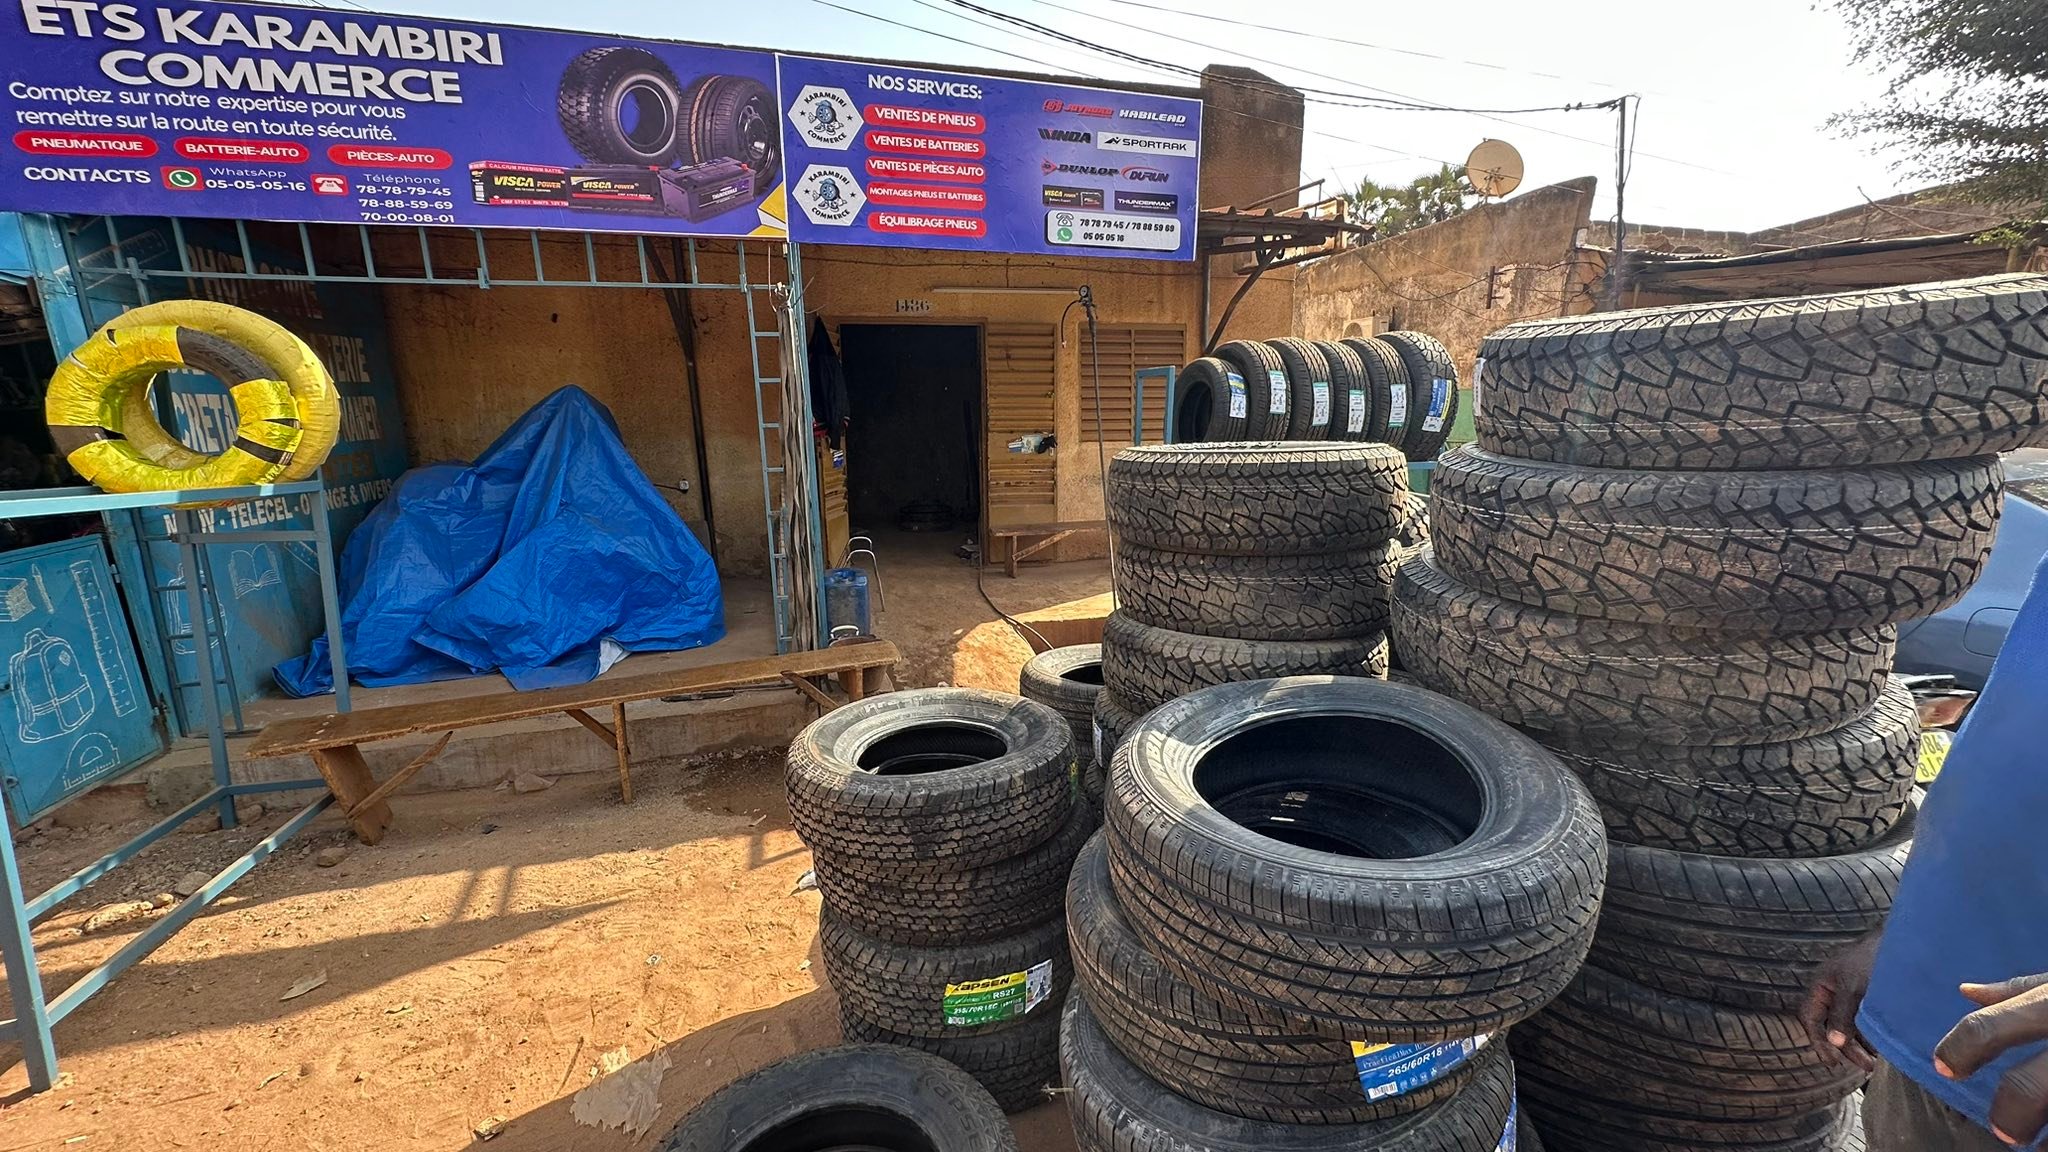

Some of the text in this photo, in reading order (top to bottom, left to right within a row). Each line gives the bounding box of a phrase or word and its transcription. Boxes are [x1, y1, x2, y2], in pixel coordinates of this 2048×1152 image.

[21, 0, 503, 66] ETS KARAMBIRI
[100, 49, 463, 103] COMMERCE
[868, 74, 983, 100] NOS SERVICES:
[8, 81, 406, 119] Comptez sur notre expertise pour vous
[803, 91, 847, 108] KARAMBIRI
[875, 107, 977, 128] VENTES DE PNEUS
[1119, 109, 1187, 124] HABILEAD
[16, 109, 398, 141] remettre sur la route en toute sécurité.
[807, 129, 848, 144] COMMERCE
[872, 134, 979, 153] VENTES DE BATTERIES
[1037, 128, 1091, 144] WINDA
[31, 137, 143, 151] PNEUMATIQUE
[185, 143, 299, 158] BATTERIE-AUTO
[1122, 138, 1187, 151] SPORTRAK
[347, 149, 435, 163] PIÈCES-AUTO
[23, 166, 151, 184] CONTACTS
[209, 167, 287, 179] WhatsApp
[868, 159, 984, 177] VENTES DE PIÈCES AUTO
[1057, 162, 1120, 176] DUNLOP
[363, 173, 441, 185] Téléphone
[493, 175, 561, 189] VISCA POWER
[808, 170, 850, 185] KARAMBIRI
[1130, 170, 1169, 183] DURUN
[205, 179, 306, 192] 05-05-05-16
[356, 184, 451, 197] 78-78-79-45
[582, 181, 612, 189] VISCA
[869, 187, 984, 202] MONTAGES PNEUS ET BATTERIES
[358, 198, 453, 210] 78-88-59-69
[360, 212, 455, 224] 70-00-08-01
[811, 206, 851, 220] COMMERCE
[879, 212, 977, 231] ÉQUILIBRAGE PNEUS
[1080, 218, 1090, 227] 78
[1091, 219, 1101, 227] 78
[1102, 220, 1112, 229] 79
[1113, 221, 1124, 229] 45
[1132, 222, 1141, 230] 78
[1153, 224, 1163, 232] 59
[1083, 231, 1125, 242] 05 05 05 16
[227, 495, 294, 530] TELECEL
[992, 988, 1016, 1000] RS27
[1387, 1047, 1443, 1078] 265/60R18
